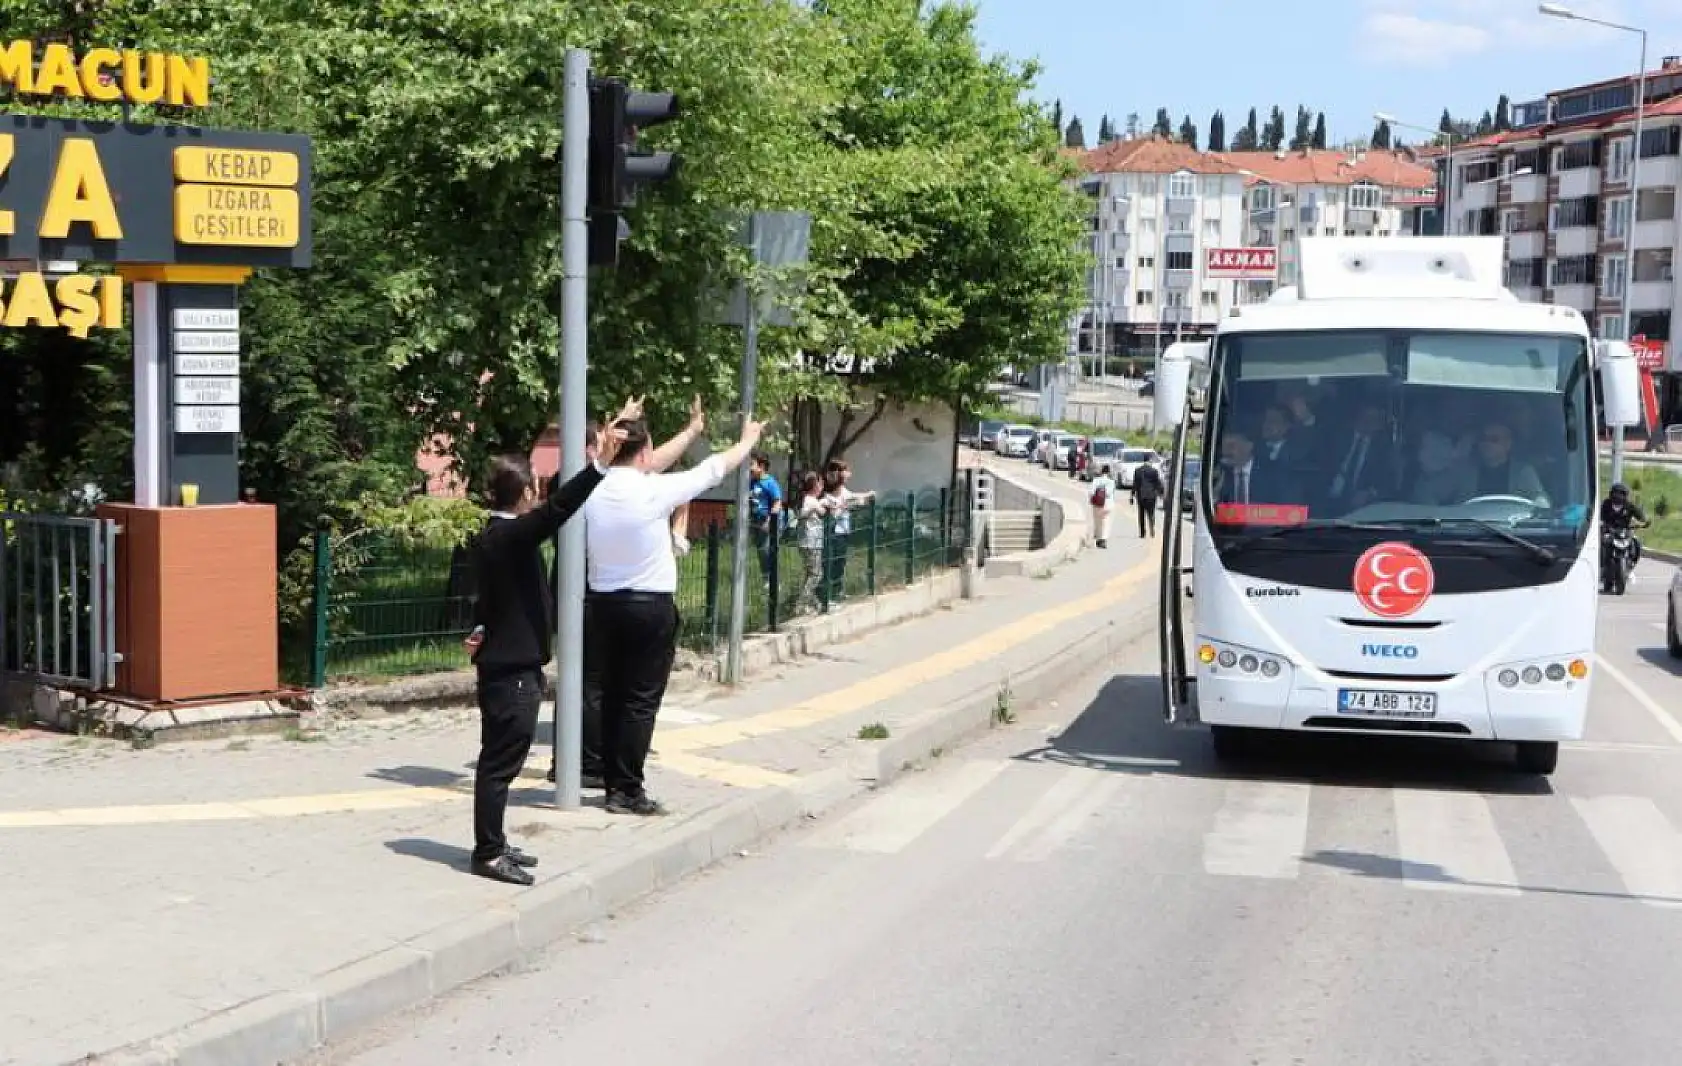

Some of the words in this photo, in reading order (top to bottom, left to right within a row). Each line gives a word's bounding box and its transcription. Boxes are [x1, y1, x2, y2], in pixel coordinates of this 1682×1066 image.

[206, 152, 272, 179] KEBAP
[207, 187, 272, 211] IZGARA
[0, 272, 123, 339] AŞI
[1246, 586, 1301, 597] Eurobus
[1361, 643, 1418, 658] IVECO
[1349, 692, 1366, 708] 74
[1407, 694, 1432, 711] 124
